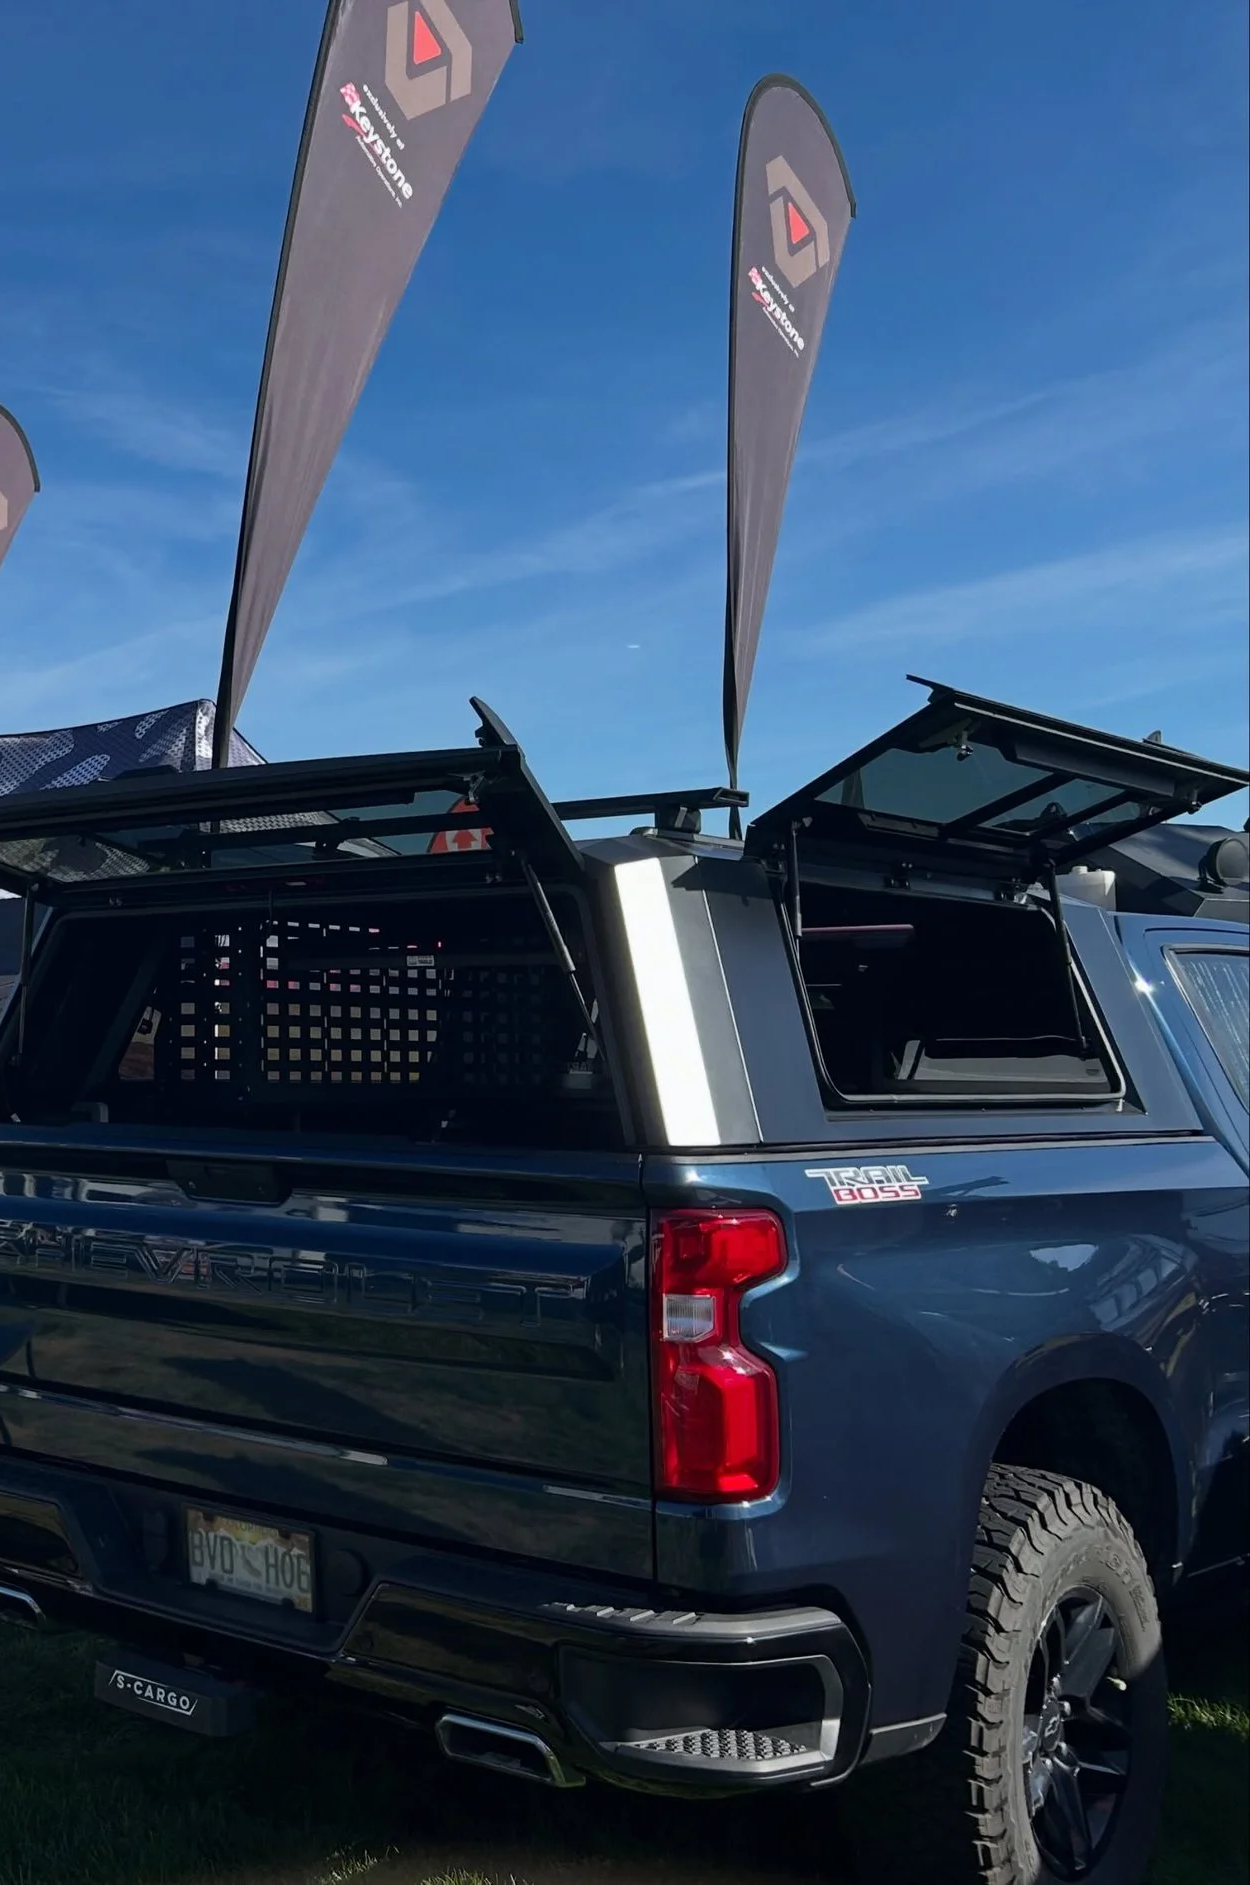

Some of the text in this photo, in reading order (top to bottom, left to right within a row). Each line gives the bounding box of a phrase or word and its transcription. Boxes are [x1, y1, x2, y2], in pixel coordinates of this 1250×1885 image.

[349, 100, 413, 199] Keystone
[755, 283, 805, 350] Keystone
[804, 1165, 930, 1188] TRAIL
[832, 1184, 922, 1205] BOSS
[190, 1531, 235, 1575] BVD
[116, 1674, 191, 1710] S-CARGO
